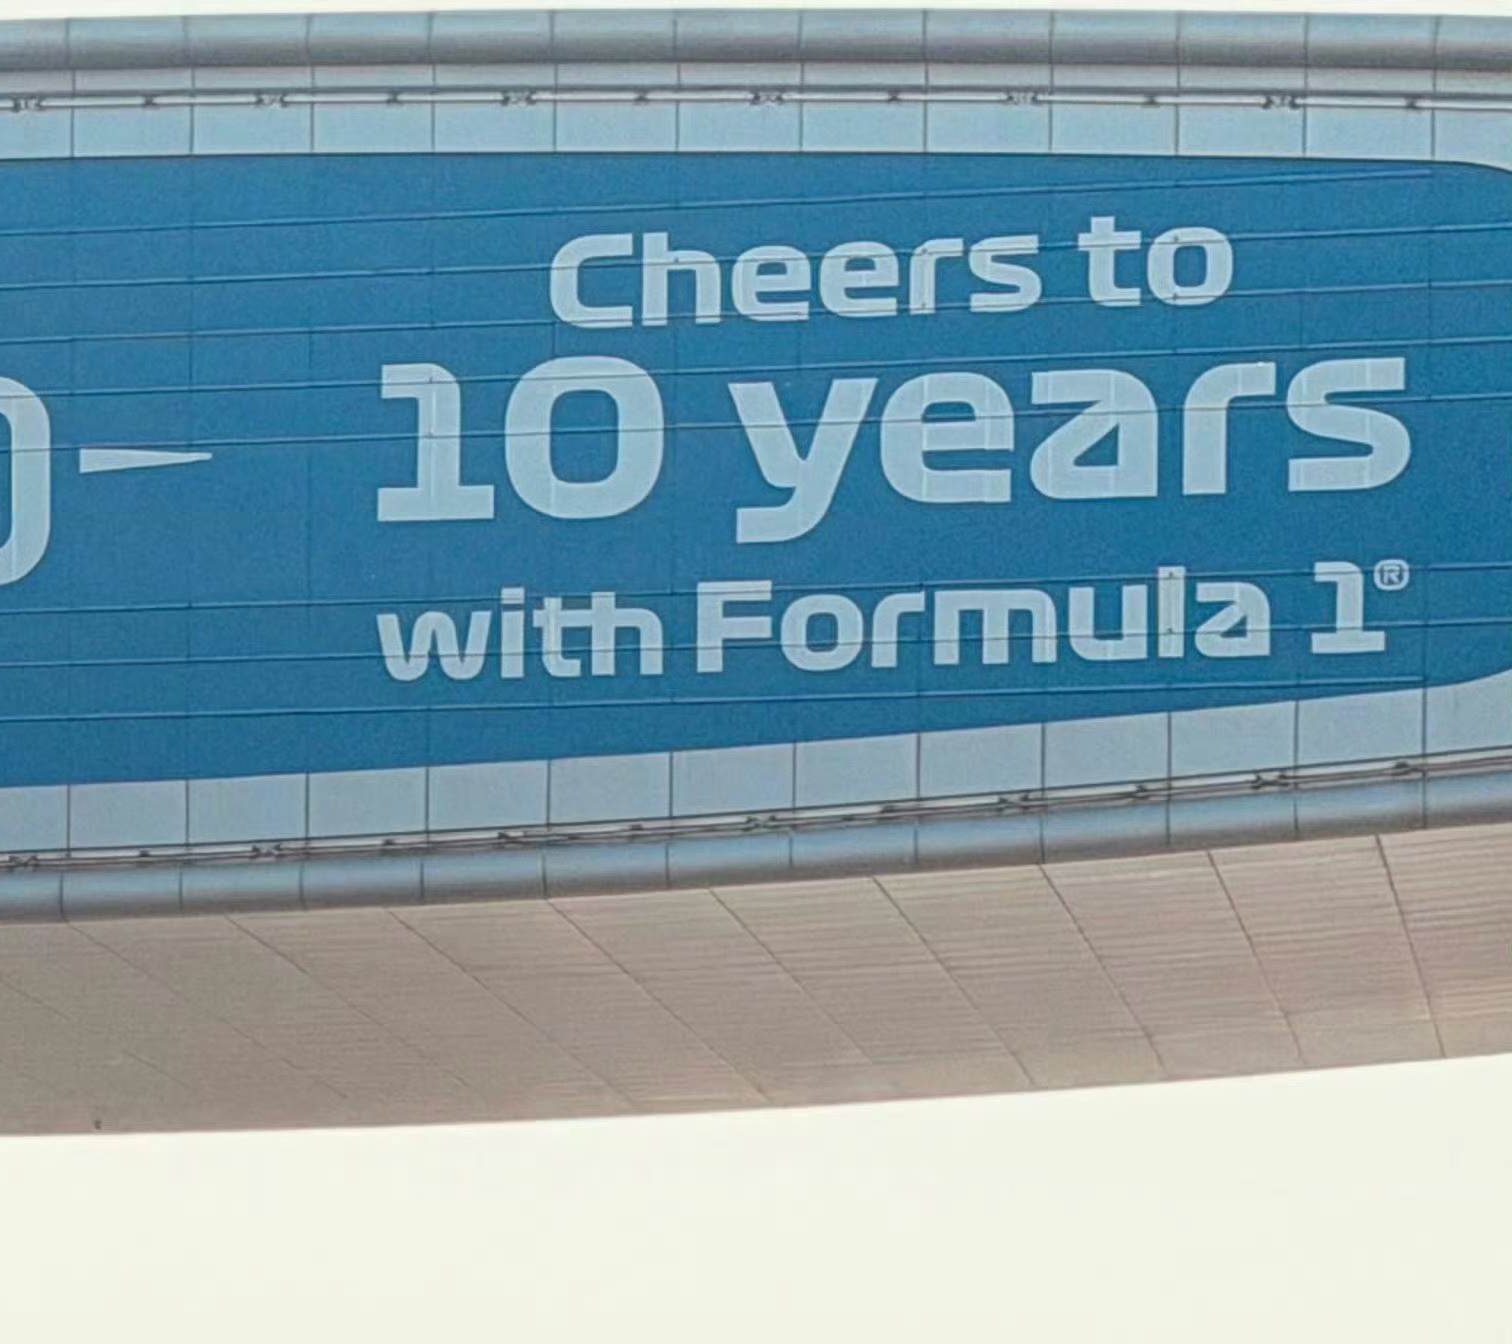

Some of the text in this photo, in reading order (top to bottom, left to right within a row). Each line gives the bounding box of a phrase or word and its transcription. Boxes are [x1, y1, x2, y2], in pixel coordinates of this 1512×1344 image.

[549, 216, 1233, 328] Cheers to
[376, 355, 1411, 545] 10 years
[376, 587, 665, 683] with
[696, 566, 1271, 674] Formula
